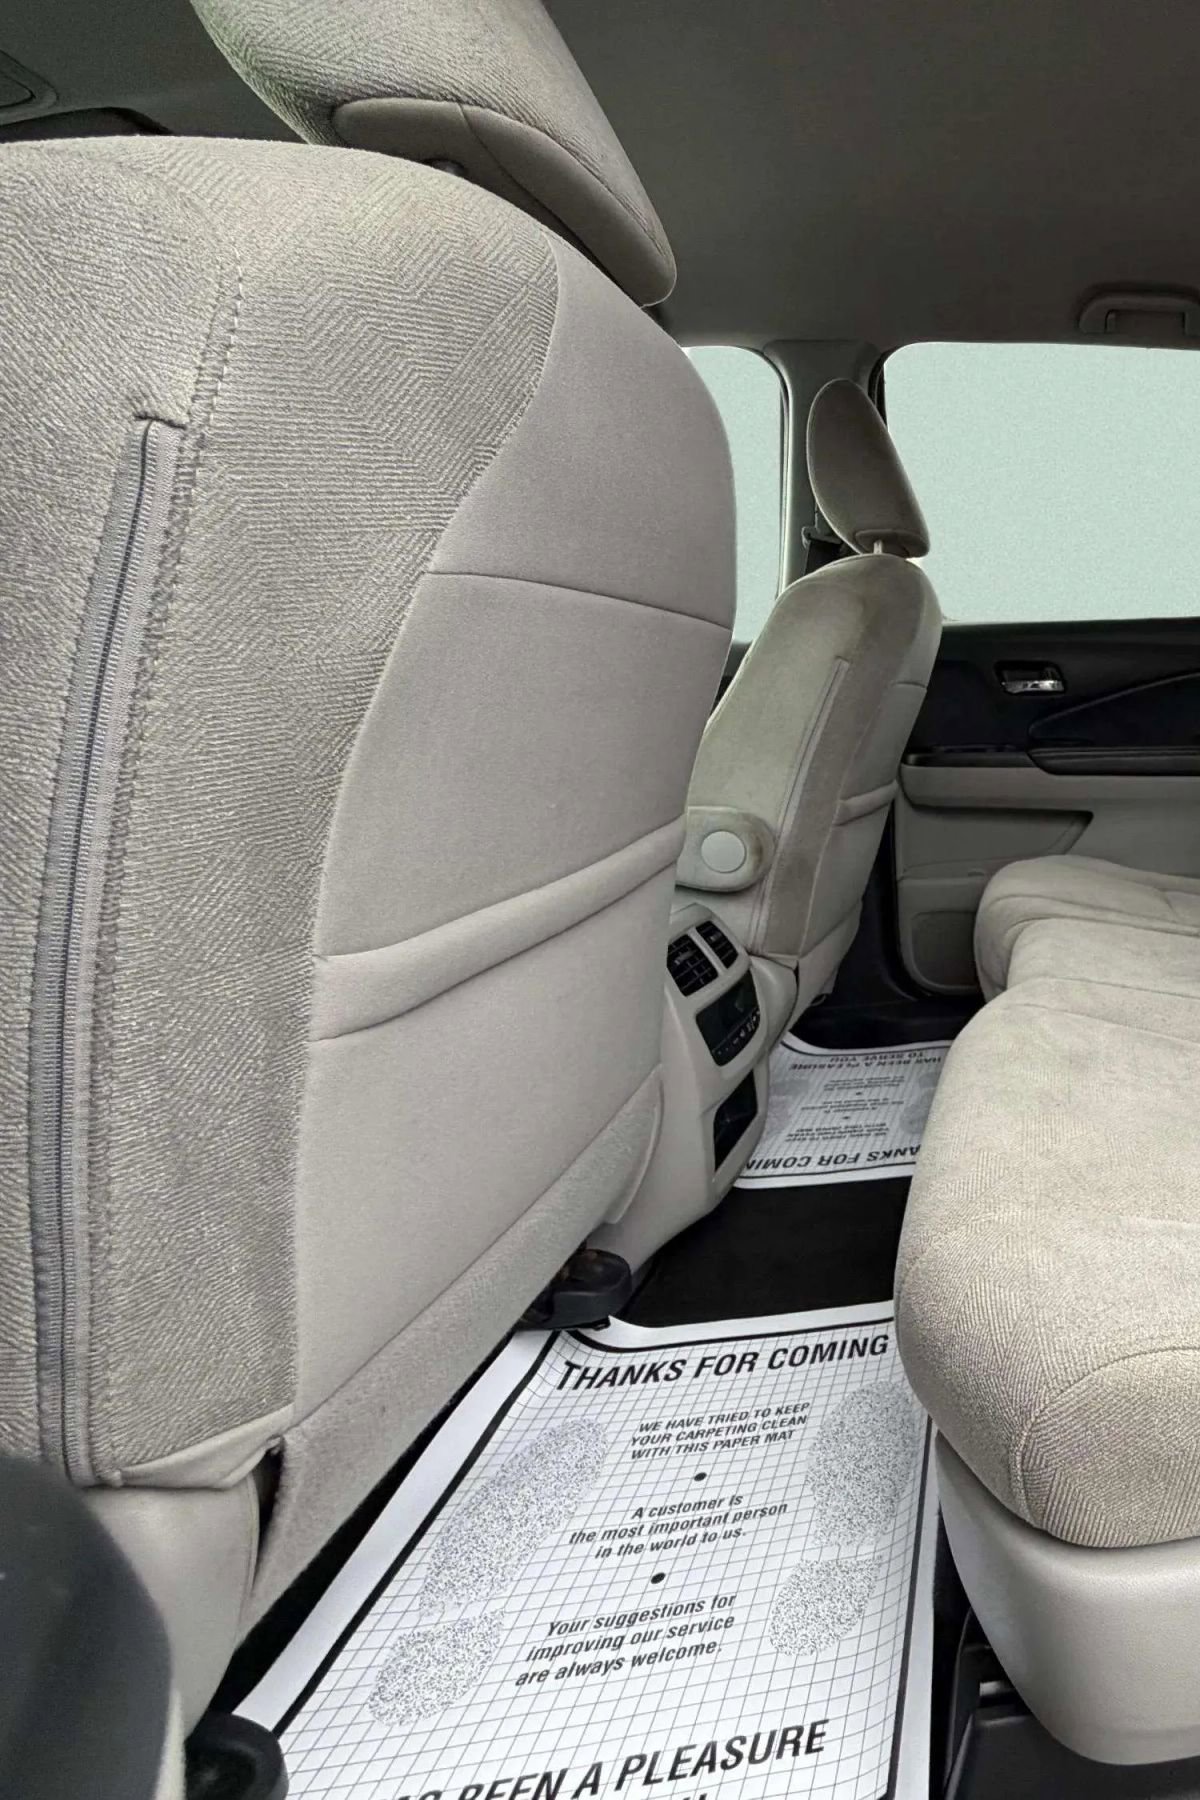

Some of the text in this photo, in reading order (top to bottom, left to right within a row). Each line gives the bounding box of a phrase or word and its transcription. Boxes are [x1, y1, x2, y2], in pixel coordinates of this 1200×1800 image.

[746, 1144, 921, 1170] ANKS FOR COMIN
[556, 1334, 889, 1391] THANKS FOR COMING
[631, 1415, 807, 1447] YOUR CARPETING CLEAN
[639, 1402, 810, 1432] WE HAVE TRIED TO KEEP
[631, 1430, 795, 1460] WITH THIS PAPER MAT
[569, 1502, 788, 1545] the most important person
[631, 1494, 744, 1520] A customer is
[595, 1526, 747, 1559] in the world to us.
[547, 1594, 737, 1637] Your suggestions for
[526, 1615, 735, 1662] improving our service
[515, 1640, 722, 1687] are always welcome.
[571, 1761, 603, 1800] A
[615, 1718, 830, 1792] PLEASURE
